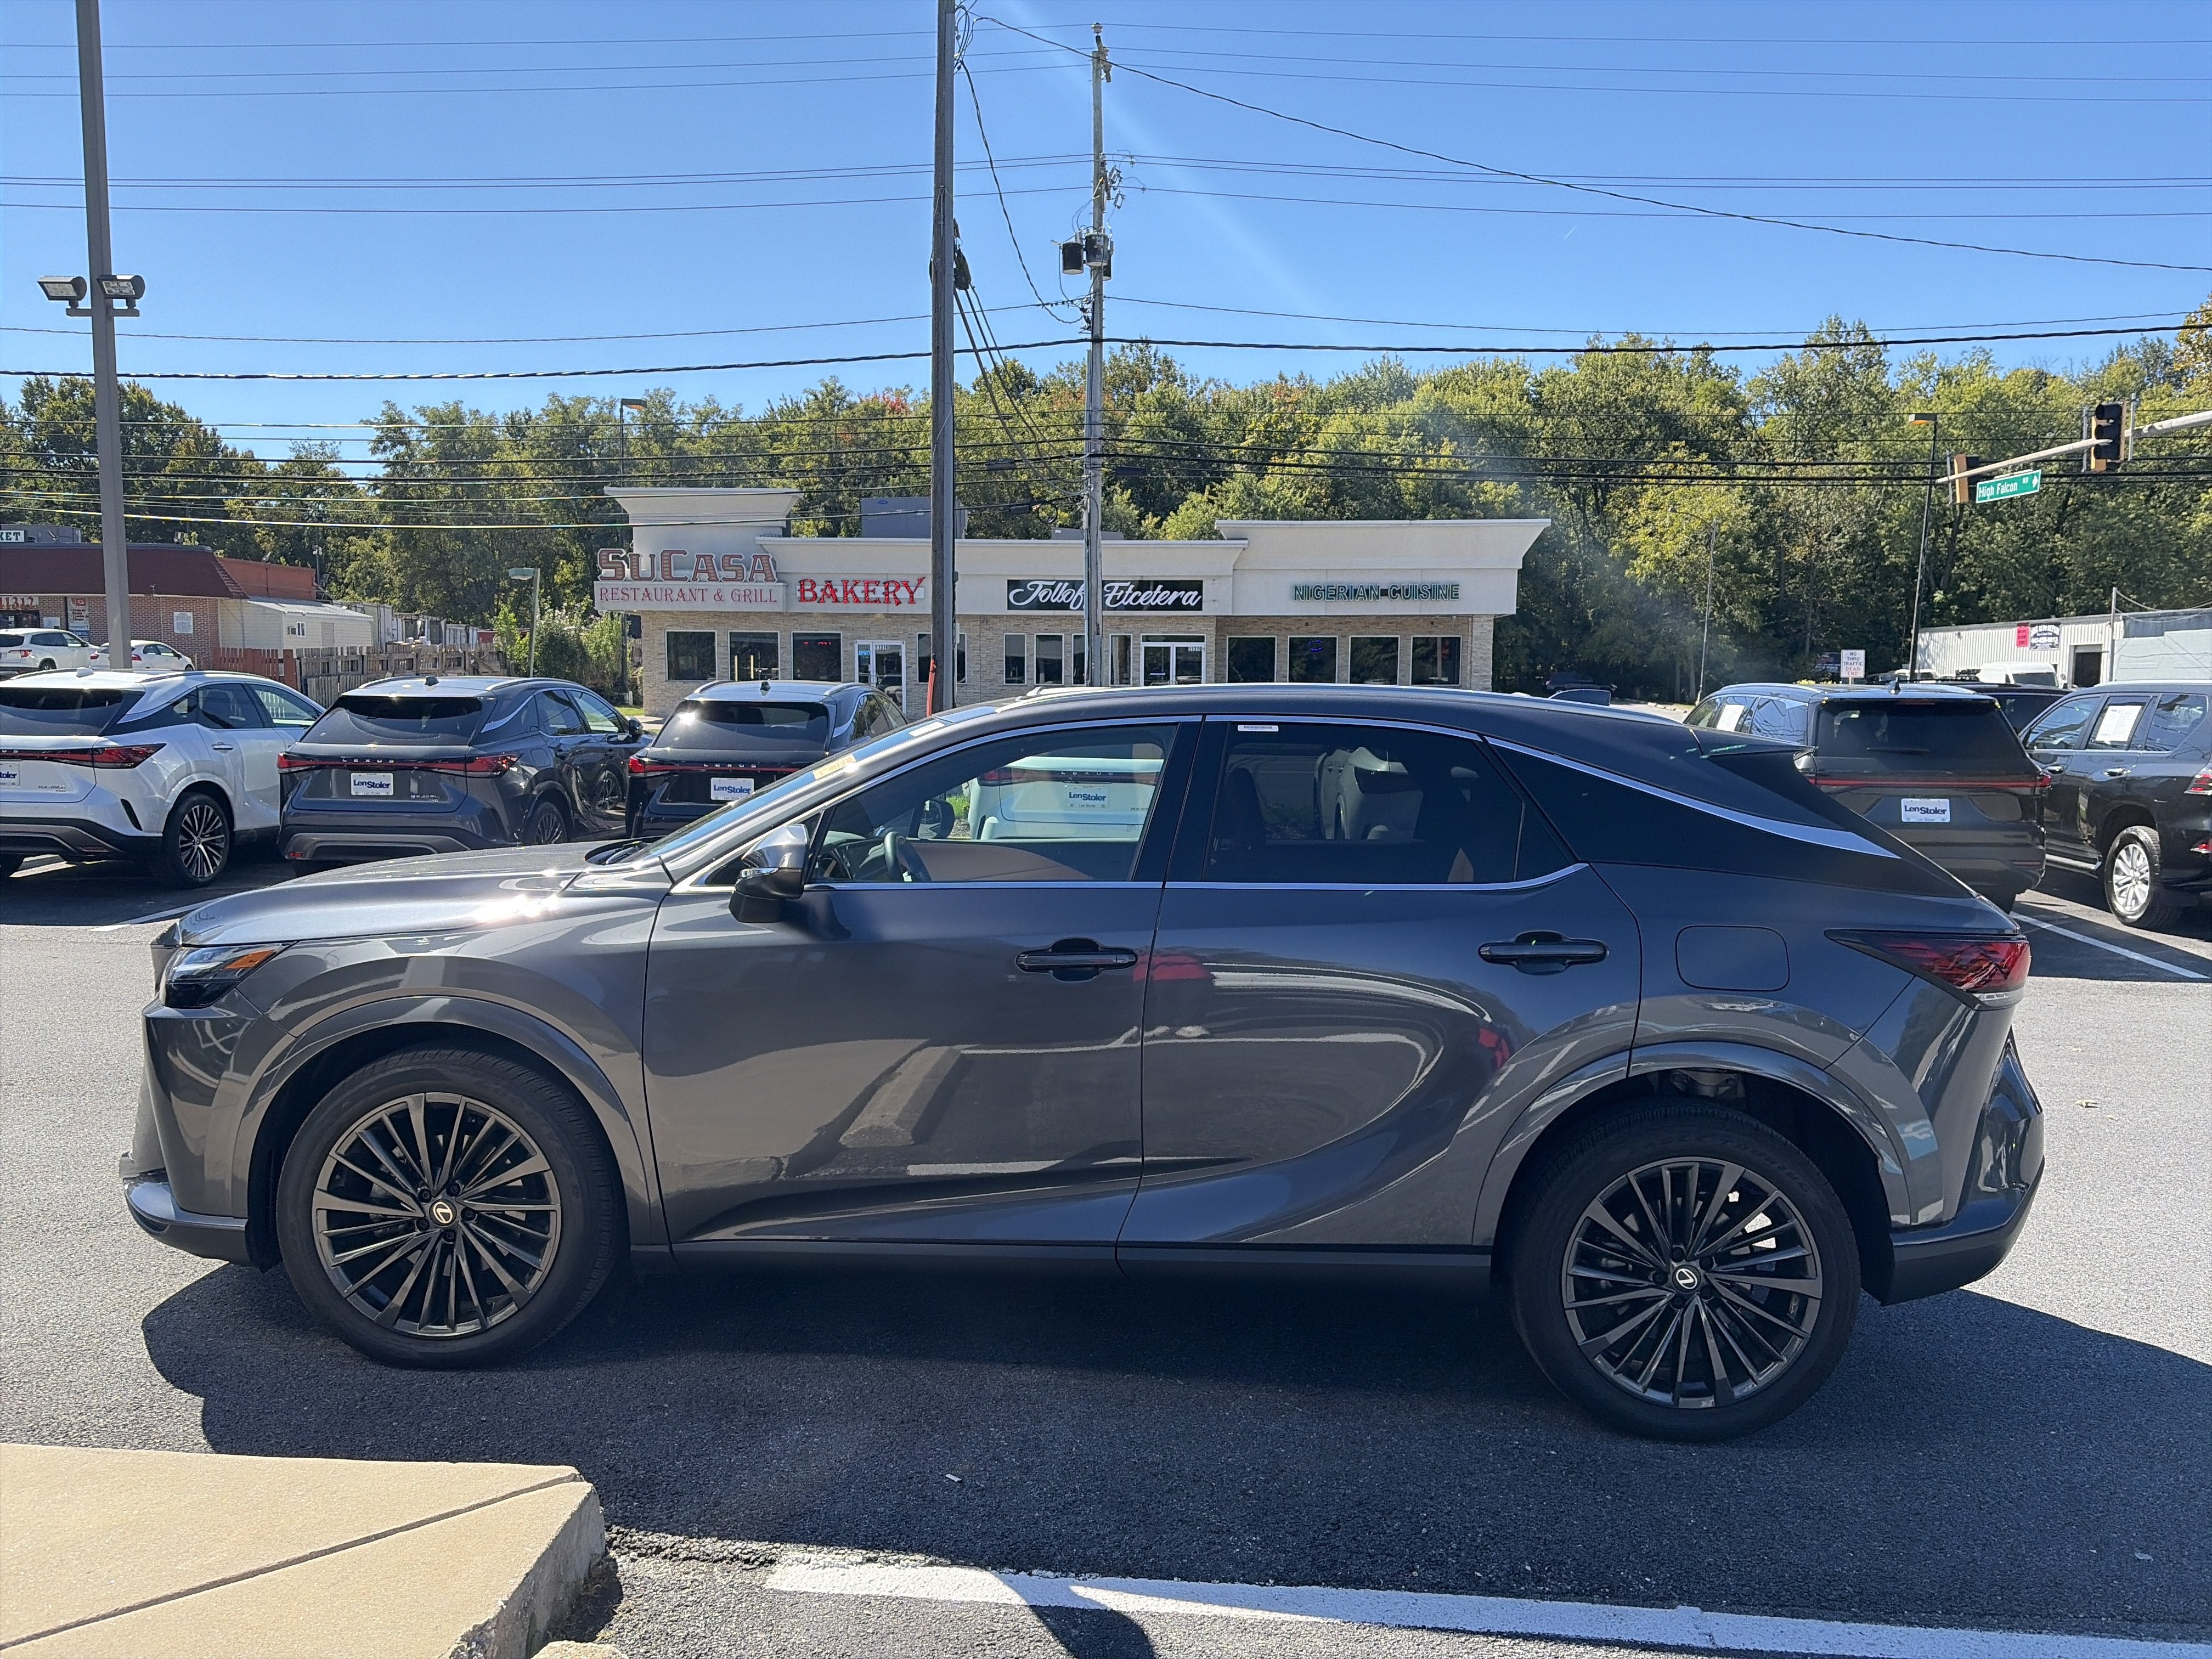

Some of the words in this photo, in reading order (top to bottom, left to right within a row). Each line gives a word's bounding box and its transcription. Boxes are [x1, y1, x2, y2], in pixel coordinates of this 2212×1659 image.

[1978, 485, 1994, 500] High
[1996, 482, 2018, 495] Falcon
[599, 587, 708, 603] RESTAURANT
[713, 590, 725, 602] &
[731, 588, 778, 603] GRILL
[798, 576, 926, 606] BAKERY
[1103, 581, 1202, 608] Etcetera
[1293, 584, 1381, 601] NIGERIAN
[1387, 583, 1460, 601] CUISINE
